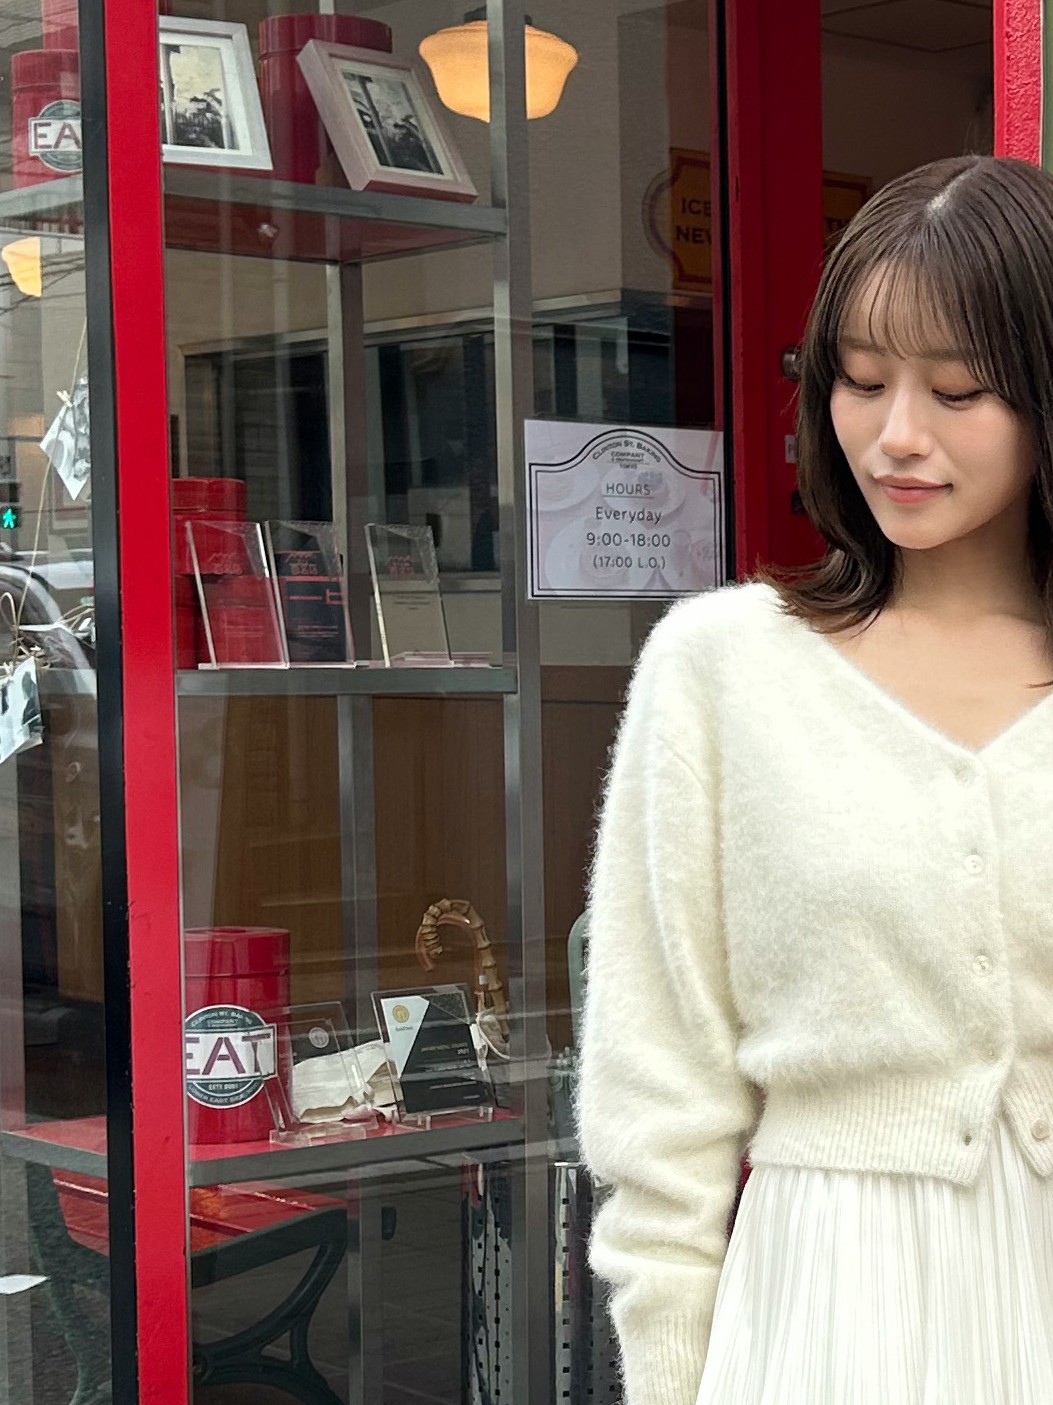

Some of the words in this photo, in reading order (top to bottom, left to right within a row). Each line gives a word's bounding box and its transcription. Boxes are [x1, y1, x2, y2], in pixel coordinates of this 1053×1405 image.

[606, 482, 651, 495] HOURS
[595, 506, 662, 524] Everyday
[586, 532, 671, 547] 9:00-18:00
[593, 556, 633, 569] (17:00
[637, 556, 666, 569] L.O.)
